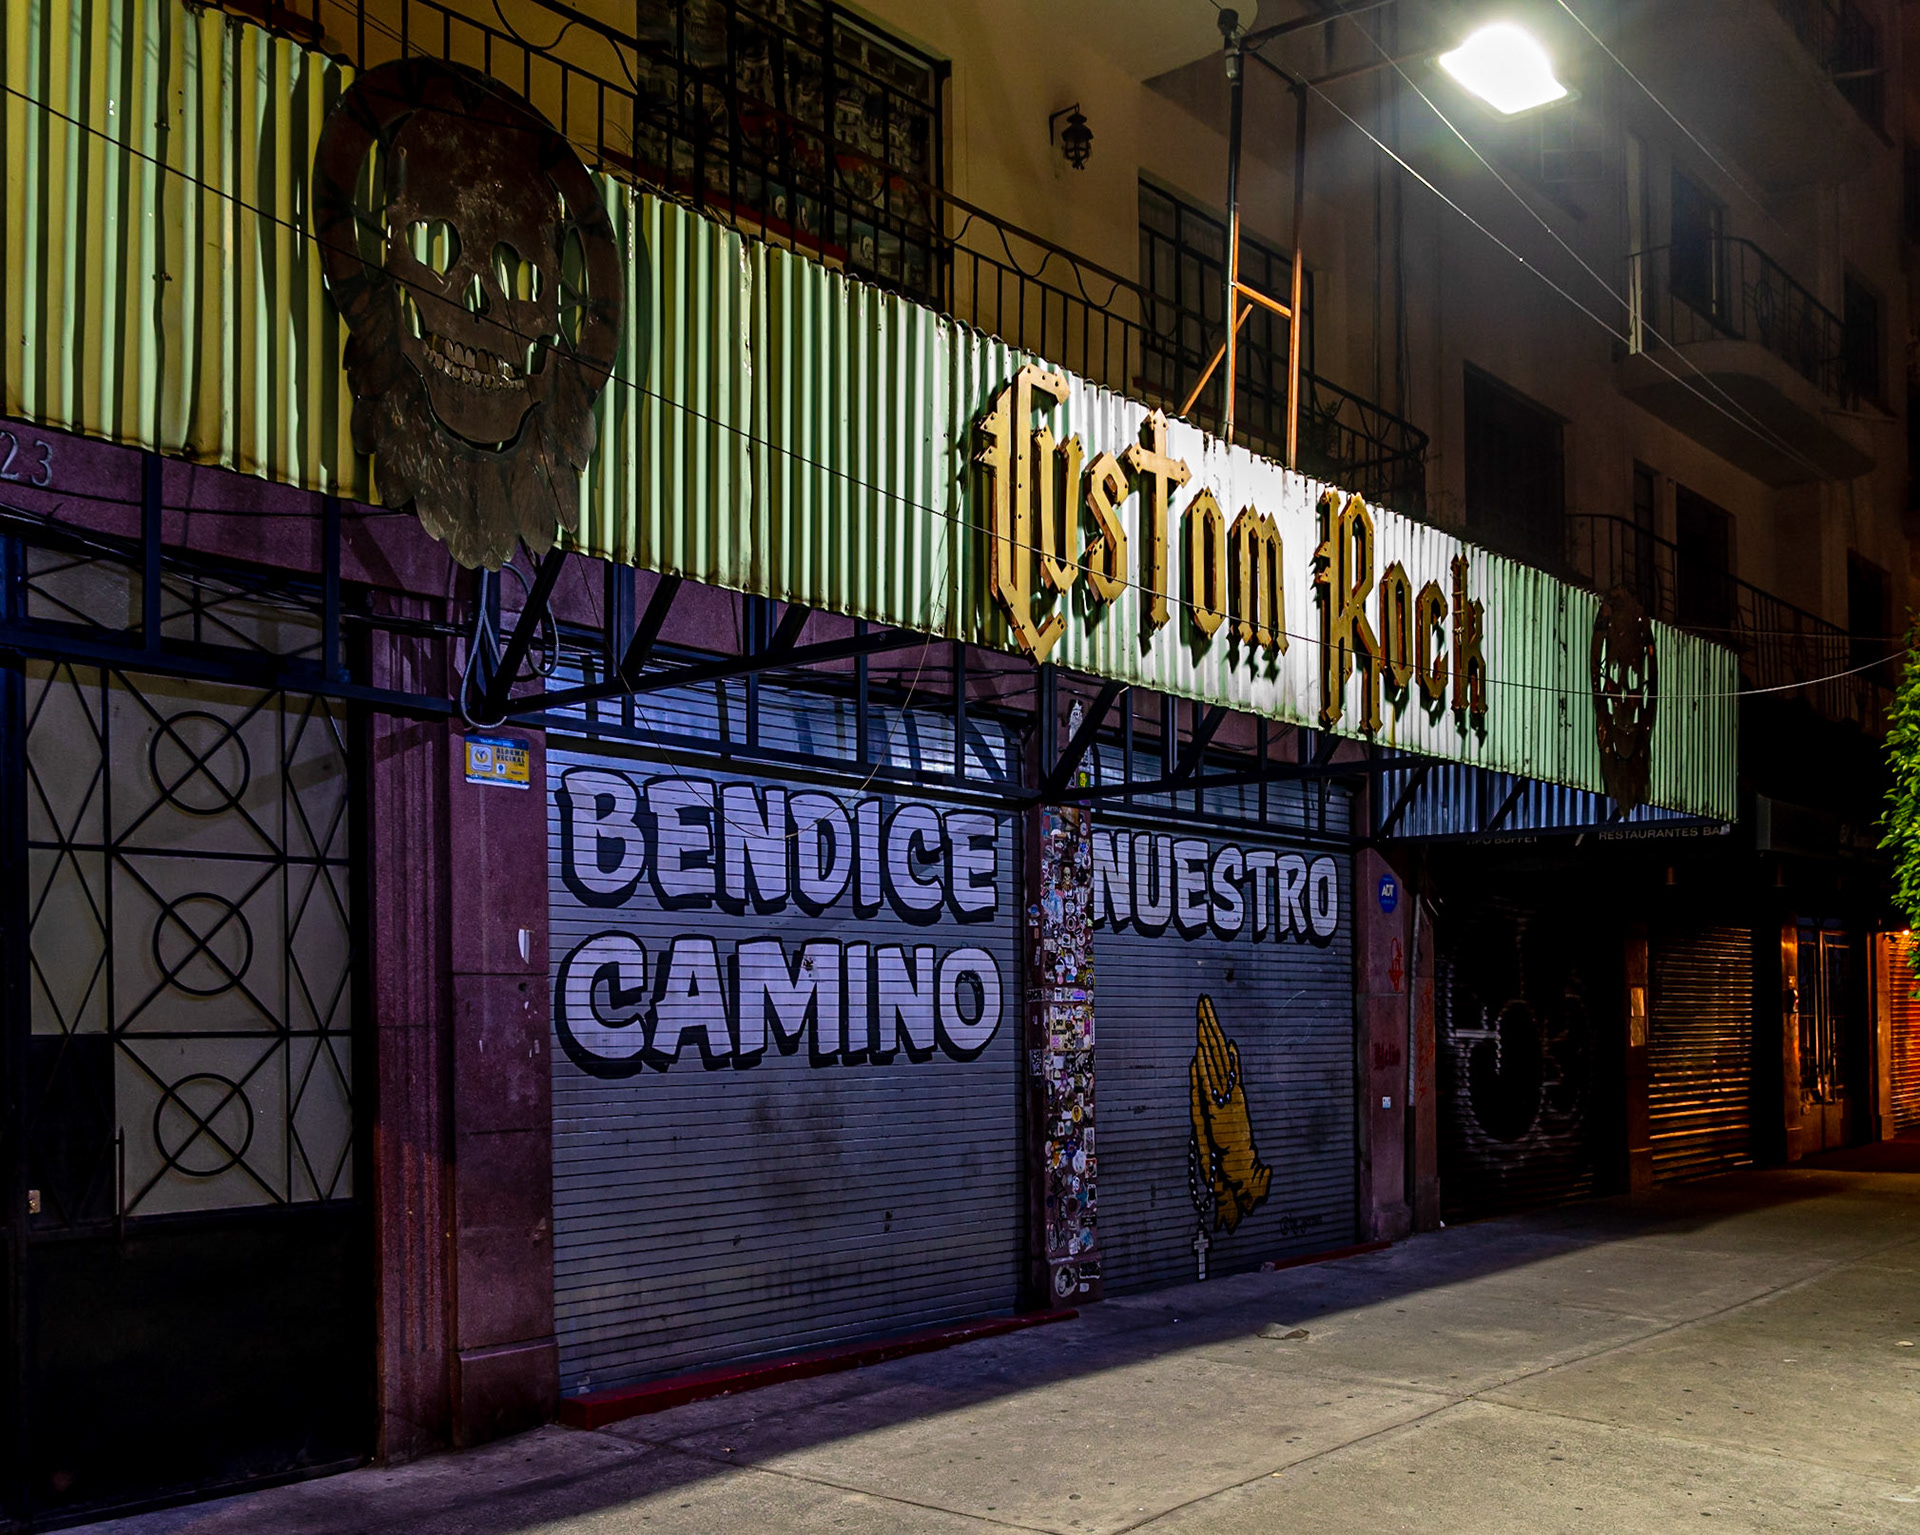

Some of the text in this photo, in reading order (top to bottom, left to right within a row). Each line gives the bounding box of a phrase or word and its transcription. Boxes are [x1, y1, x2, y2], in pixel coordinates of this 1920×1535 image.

[974, 363, 1489, 734] Custom Rock
[555, 766, 999, 925] BENDICE
[1092, 829, 1339, 948] NUESTRO
[1381, 883, 1395, 898] ADT
[1599, 827, 1699, 841] RESTAURANTES
[555, 930, 1004, 1079] CAMINO
